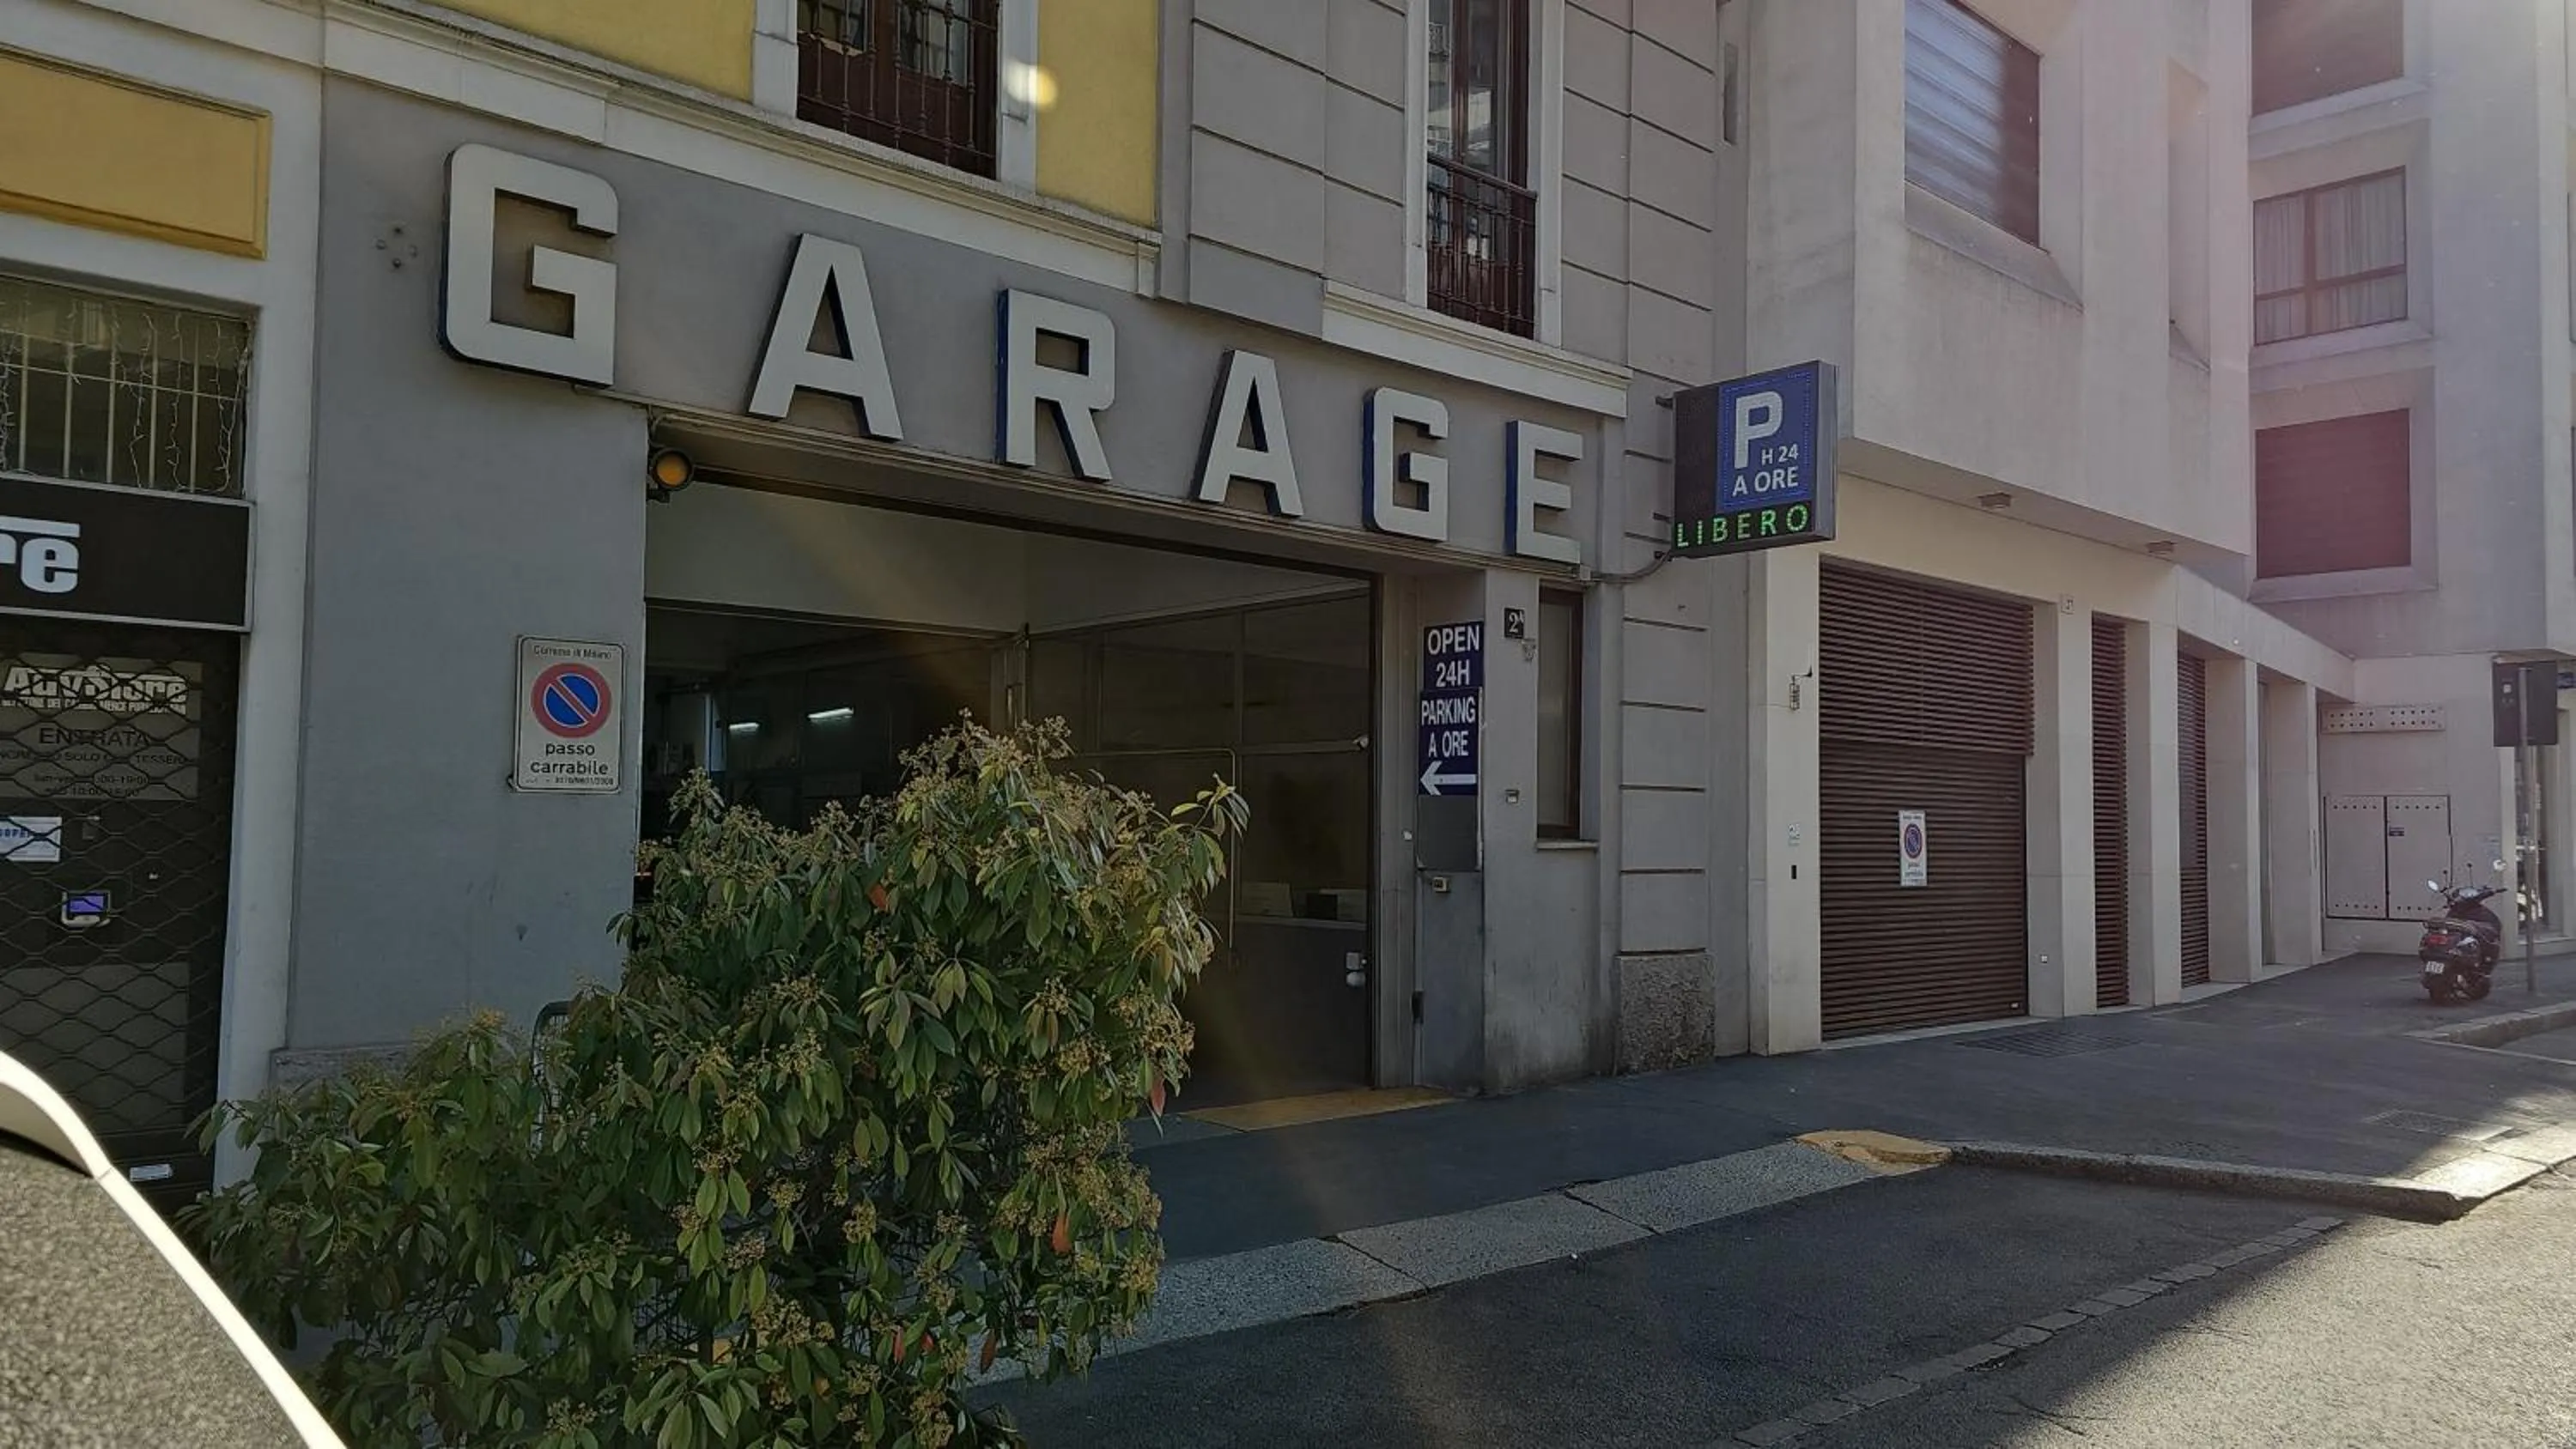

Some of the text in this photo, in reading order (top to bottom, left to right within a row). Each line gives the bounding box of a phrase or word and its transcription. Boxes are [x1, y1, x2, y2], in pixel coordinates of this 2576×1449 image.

[443, 144, 1585, 564] GARAGE
[1734, 391, 1783, 470] P
[1761, 443, 1800, 465] H 24
[1732, 466, 1800, 497] A ORE
[1677, 504, 1808, 547] LIBERO
[1427, 625, 1480, 655] OPEN
[1436, 660, 1470, 688] 24H
[1421, 696, 1476, 725] PARKING
[545, 743, 595, 756] passo
[1428, 731, 1469, 757] A ORE
[530, 759, 609, 774] carrabile
